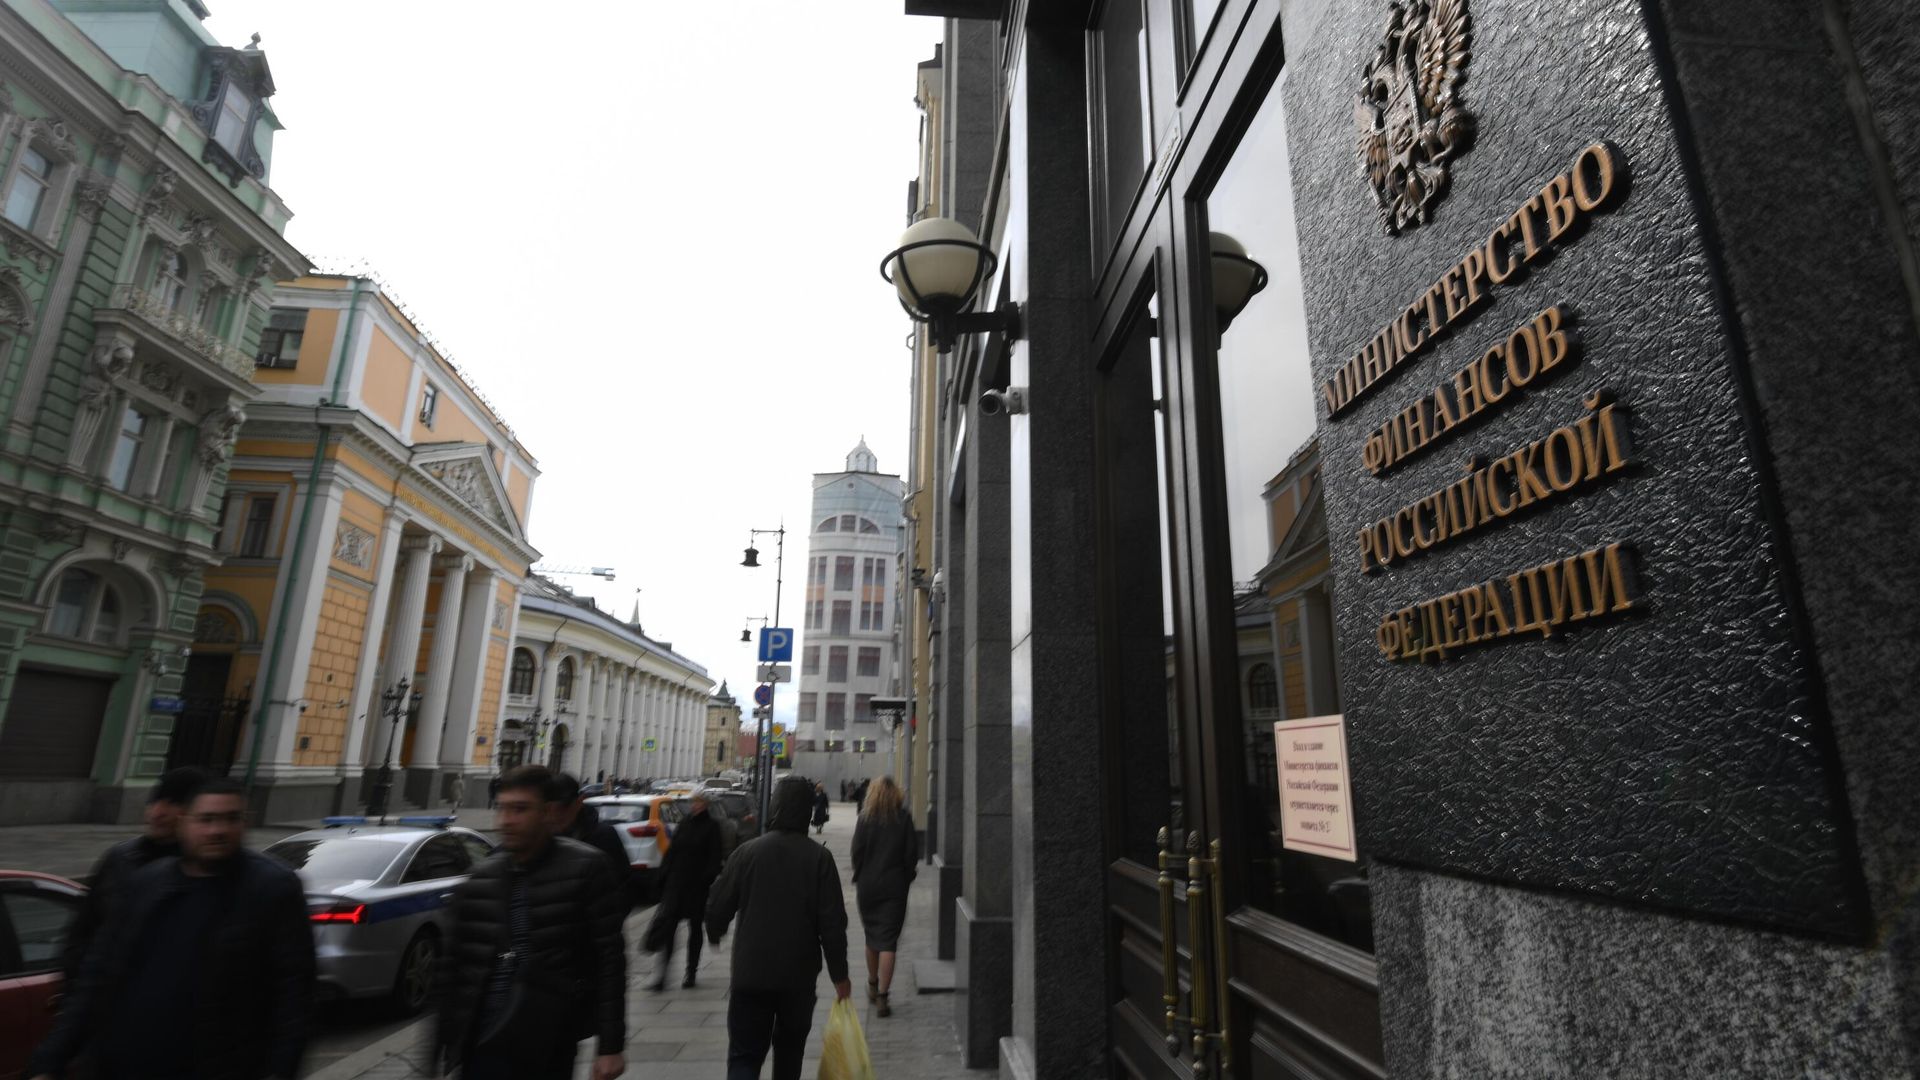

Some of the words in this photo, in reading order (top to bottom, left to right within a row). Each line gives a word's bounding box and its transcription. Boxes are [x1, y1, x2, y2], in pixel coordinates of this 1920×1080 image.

[1321, 143, 1615, 418] МИНИСТЕРСТВО
[1362, 305, 1569, 475] ФИНАНСОВ
[1356, 389, 1629, 574] РОССИЙСКОЙ
[767, 631, 787, 658] P
[1377, 542, 1633, 664] ФЕДЕРАЦИИ
